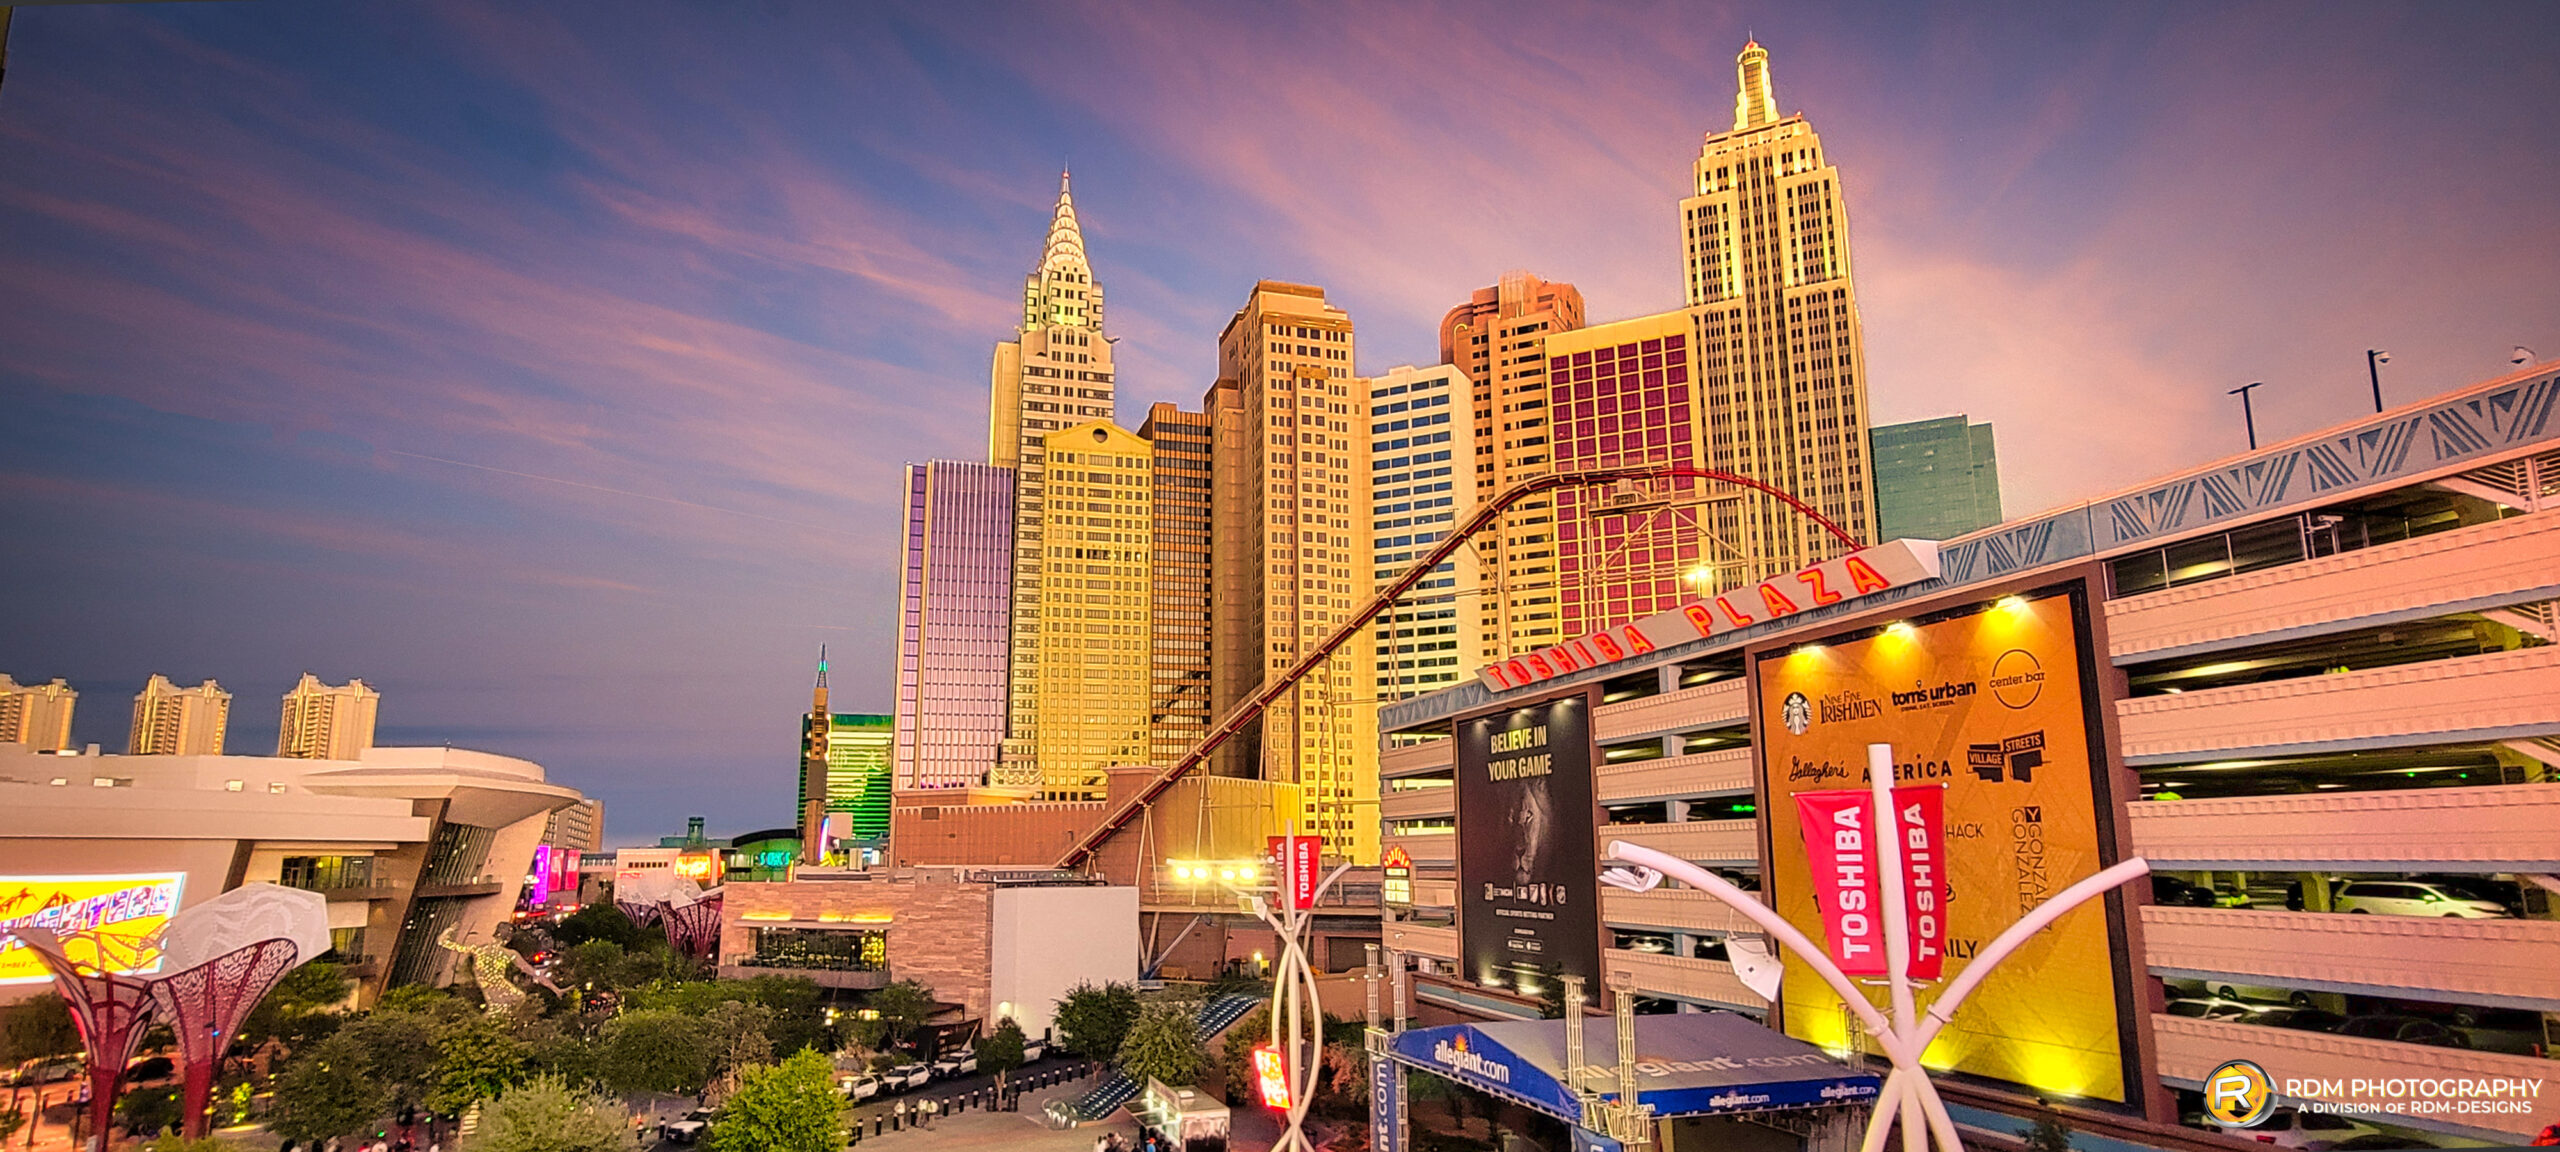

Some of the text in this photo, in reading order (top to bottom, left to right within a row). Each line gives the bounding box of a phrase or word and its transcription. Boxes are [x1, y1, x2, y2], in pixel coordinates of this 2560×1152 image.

[1488, 556, 1890, 690] TOSHIBA PLAZA
[1930, 681, 1976, 701] urban
[1989, 671, 2046, 689] center bar
[1490, 725, 1547, 754] BELIEVE IN
[1969, 734, 2042, 765] VILLAGE STREETS
[1488, 753, 1552, 782] YOUR GAME
[1789, 755, 1850, 784] Gallagher's
[1861, 760, 1952, 784] AERICA
[1944, 822, 1984, 839] HACK
[1299, 842, 1310, 900] TOSHIBA
[1833, 806, 1871, 959] TOSHIBA
[1903, 802, 1937, 962] TOSHIBA
[1434, 1039, 1509, 1084] allegiant.com
[1709, 1094, 1770, 1108] allegiant.com
